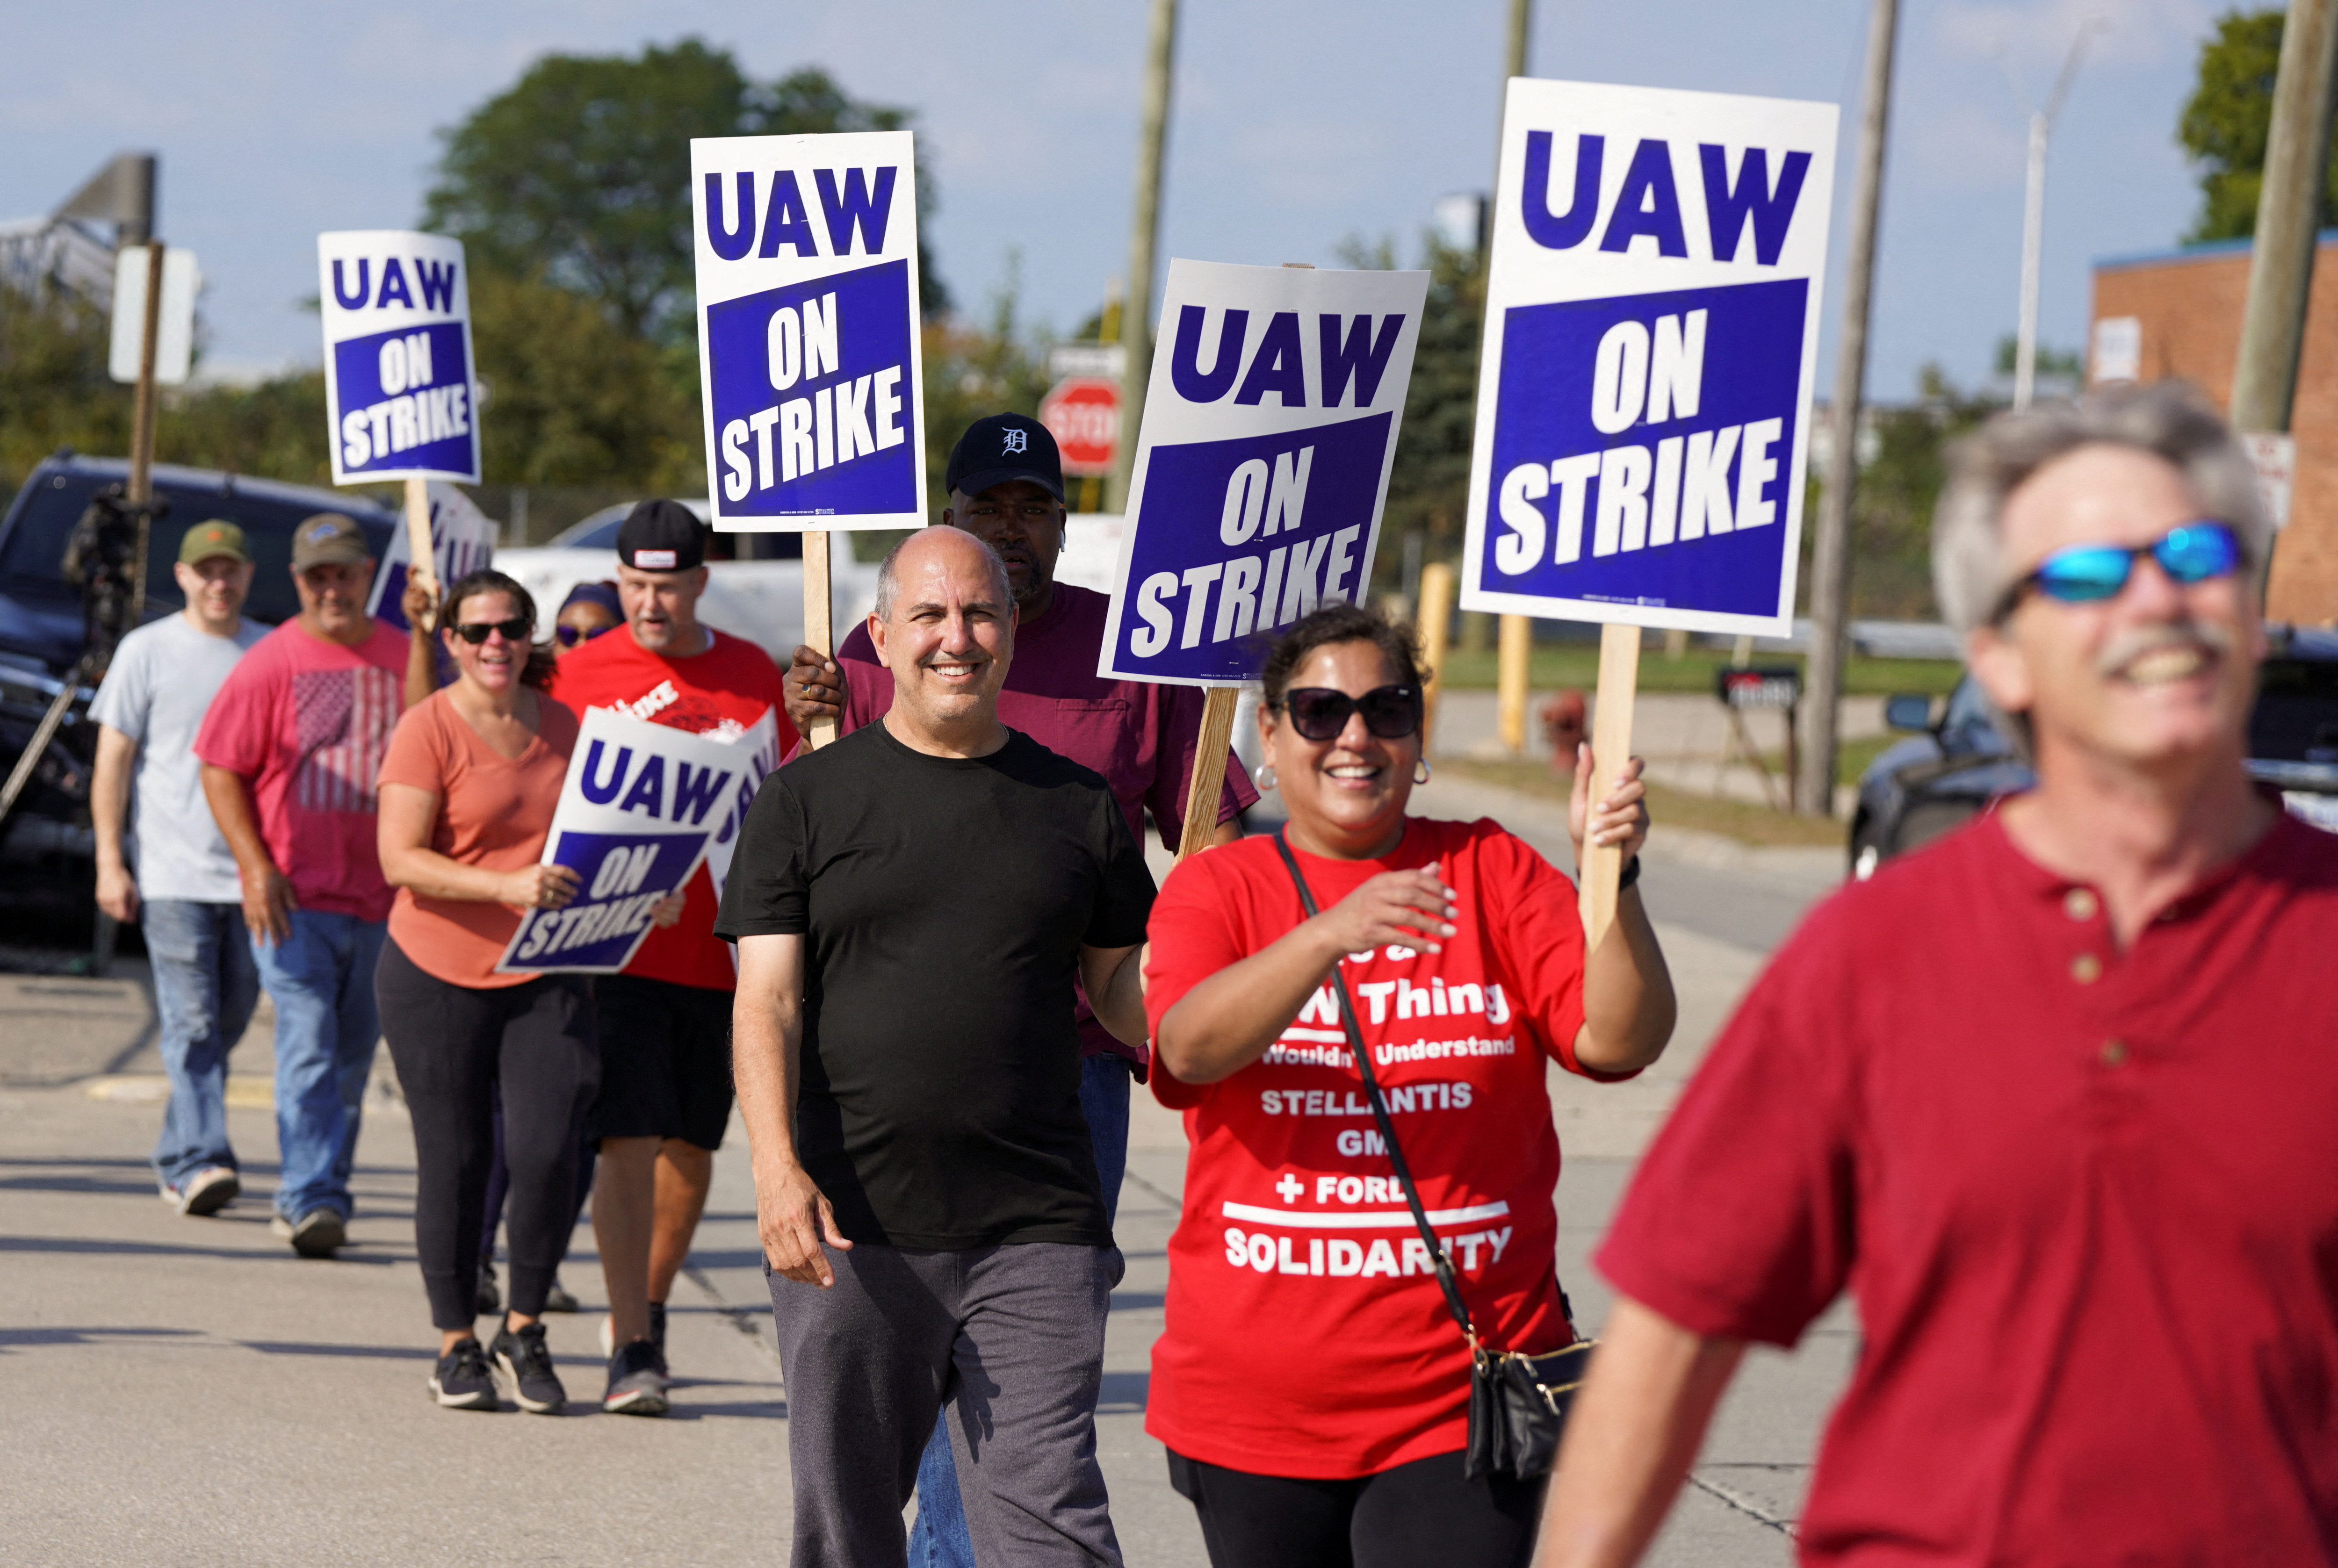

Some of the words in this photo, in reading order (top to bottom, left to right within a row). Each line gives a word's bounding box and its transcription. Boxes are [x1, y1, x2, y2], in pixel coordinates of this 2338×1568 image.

[705, 166, 897, 261] UAW
[1522, 130, 1813, 266] UAW
[332, 257, 456, 314] UAW
[378, 331, 433, 396] ON
[768, 292, 838, 390] ON
[1171, 304, 1406, 408] UAW
[1591, 308, 1708, 434] ON
[342, 382, 469, 468] STRIKE
[722, 365, 904, 501] STRIKE
[1002, 427, 1028, 456] D
[1220, 445, 1314, 546] ON
[1495, 417, 1782, 575] STRIKE
[1130, 524, 1360, 658] STRIKE
[581, 739, 731, 826] UAW
[589, 843, 660, 900] ON
[517, 889, 668, 960] STRIKE
[1358, 976, 1510, 1024] Thing
[1375, 1035, 1515, 1065] Understand
[1261, 1081, 1472, 1115] STELLANTIS
[1224, 1226, 1512, 1277] SOLIDARITY
